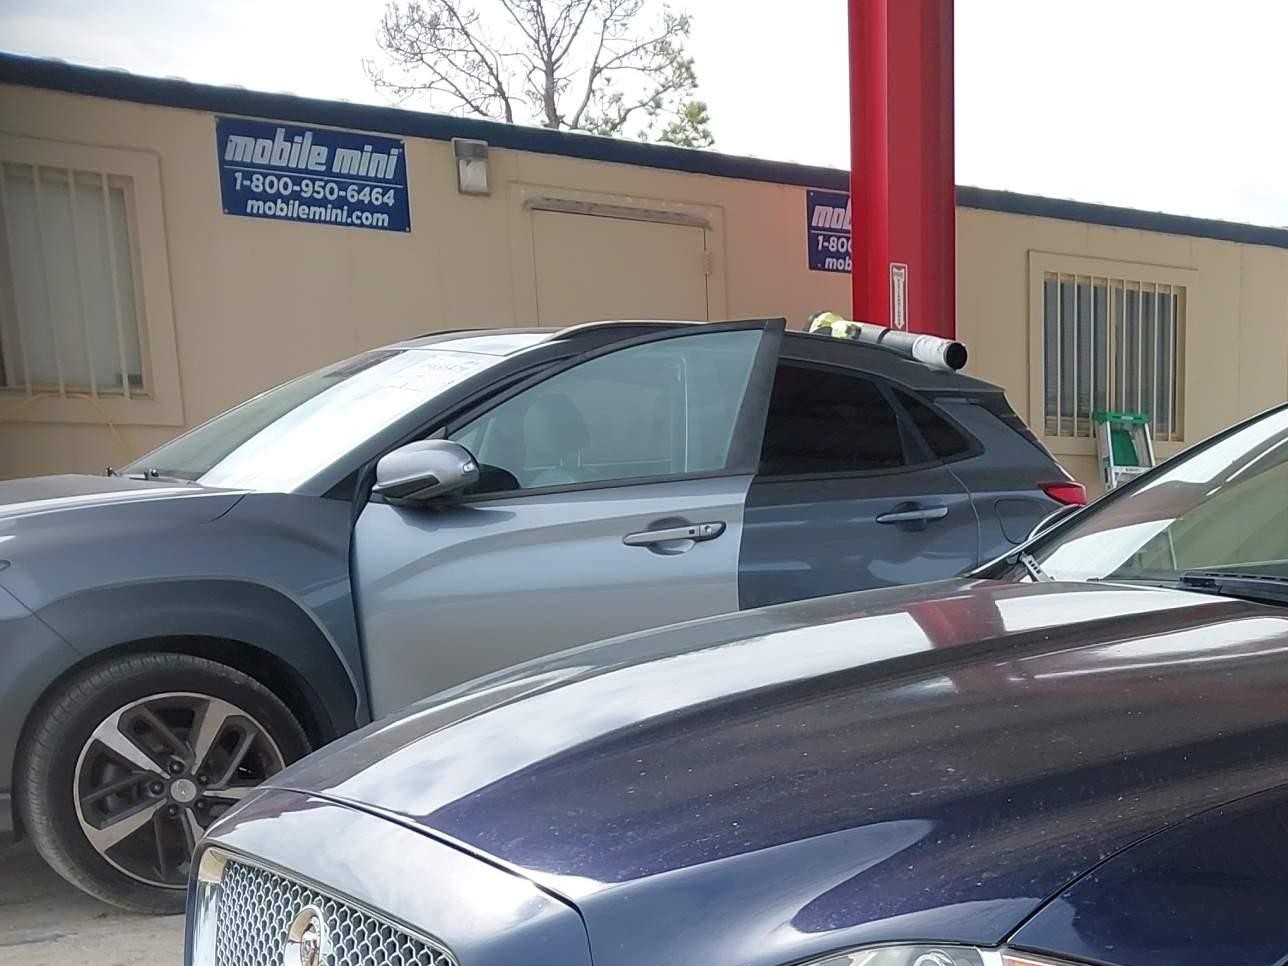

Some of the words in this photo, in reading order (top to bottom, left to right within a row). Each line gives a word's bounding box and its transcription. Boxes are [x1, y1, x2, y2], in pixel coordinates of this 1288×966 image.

[225, 128, 329, 171] mobile
[332, 145, 399, 179] mini
[234, 172, 395, 206] 1-800-950-6464
[246, 199, 389, 227] mobilemini.com
